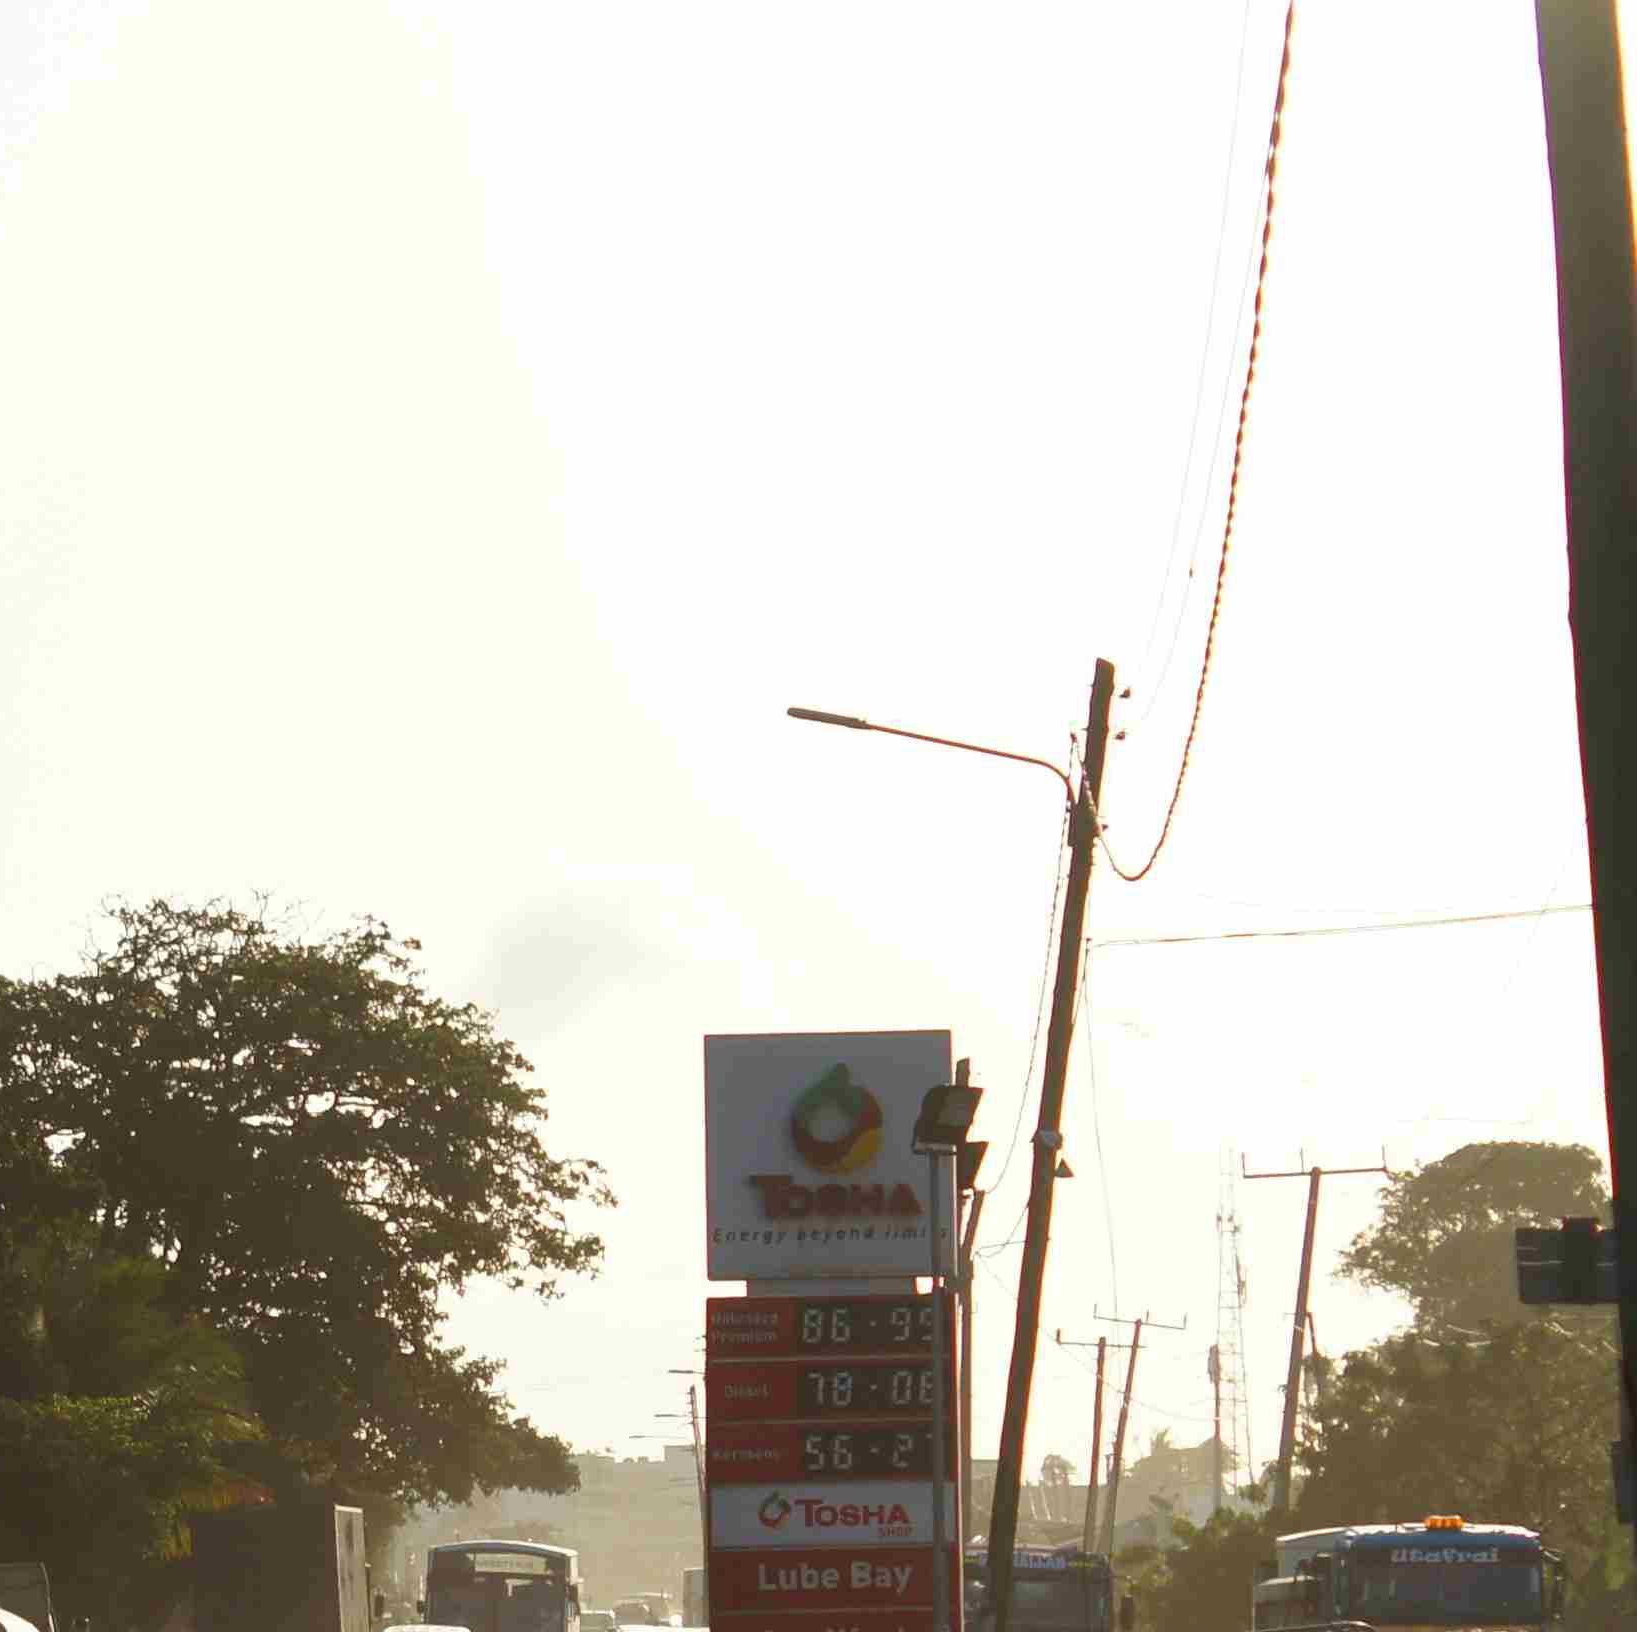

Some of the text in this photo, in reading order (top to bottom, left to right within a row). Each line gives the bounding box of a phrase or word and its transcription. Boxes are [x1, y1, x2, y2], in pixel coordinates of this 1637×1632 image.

[712, 1226, 784, 1248] Energy
[797, 1225, 874, 1248] beyond
[794, 1499, 911, 1528] TOSHA
[757, 1560, 913, 1593] Lube Bay
